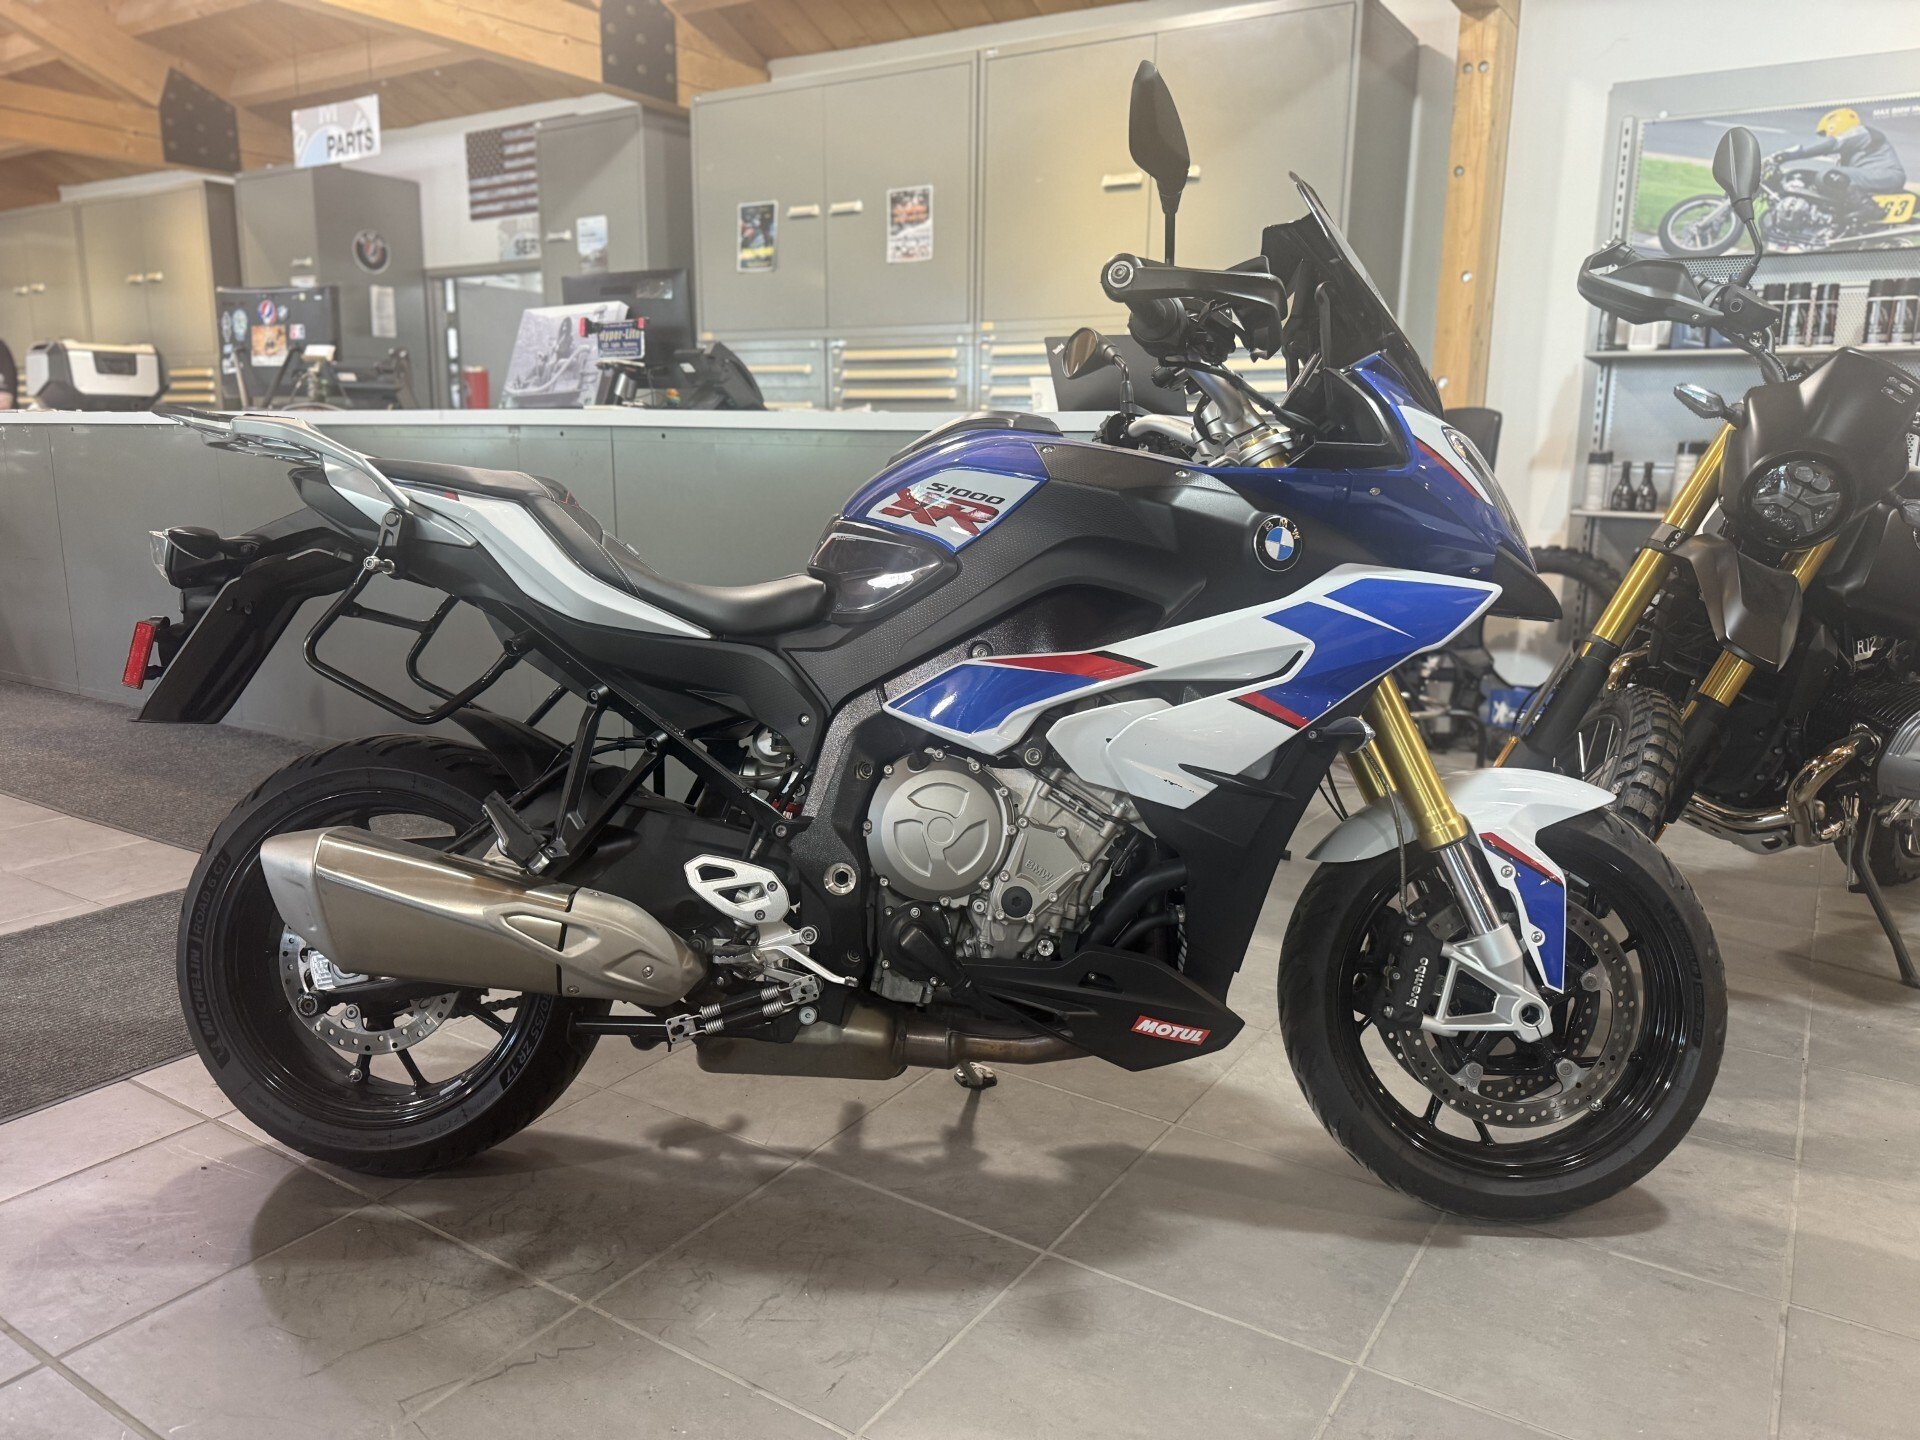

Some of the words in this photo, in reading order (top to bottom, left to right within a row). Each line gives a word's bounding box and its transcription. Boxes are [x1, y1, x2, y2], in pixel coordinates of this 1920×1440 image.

[326, 128, 375, 159] PARTS
[926, 482, 1006, 505] S1000
[877, 487, 1000, 537] XR
[1262, 517, 1301, 540] BMW
[213, 855, 227, 876] GT
[1025, 858, 1054, 881] BMW
[194, 890, 212, 932] ROAD
[190, 949, 216, 1036] MICHELIN
[1405, 956, 1429, 1009] brembo
[1136, 1019, 1204, 1042] MOTUL
[518, 1041, 533, 1064] ZR
[505, 1063, 518, 1083] 17
